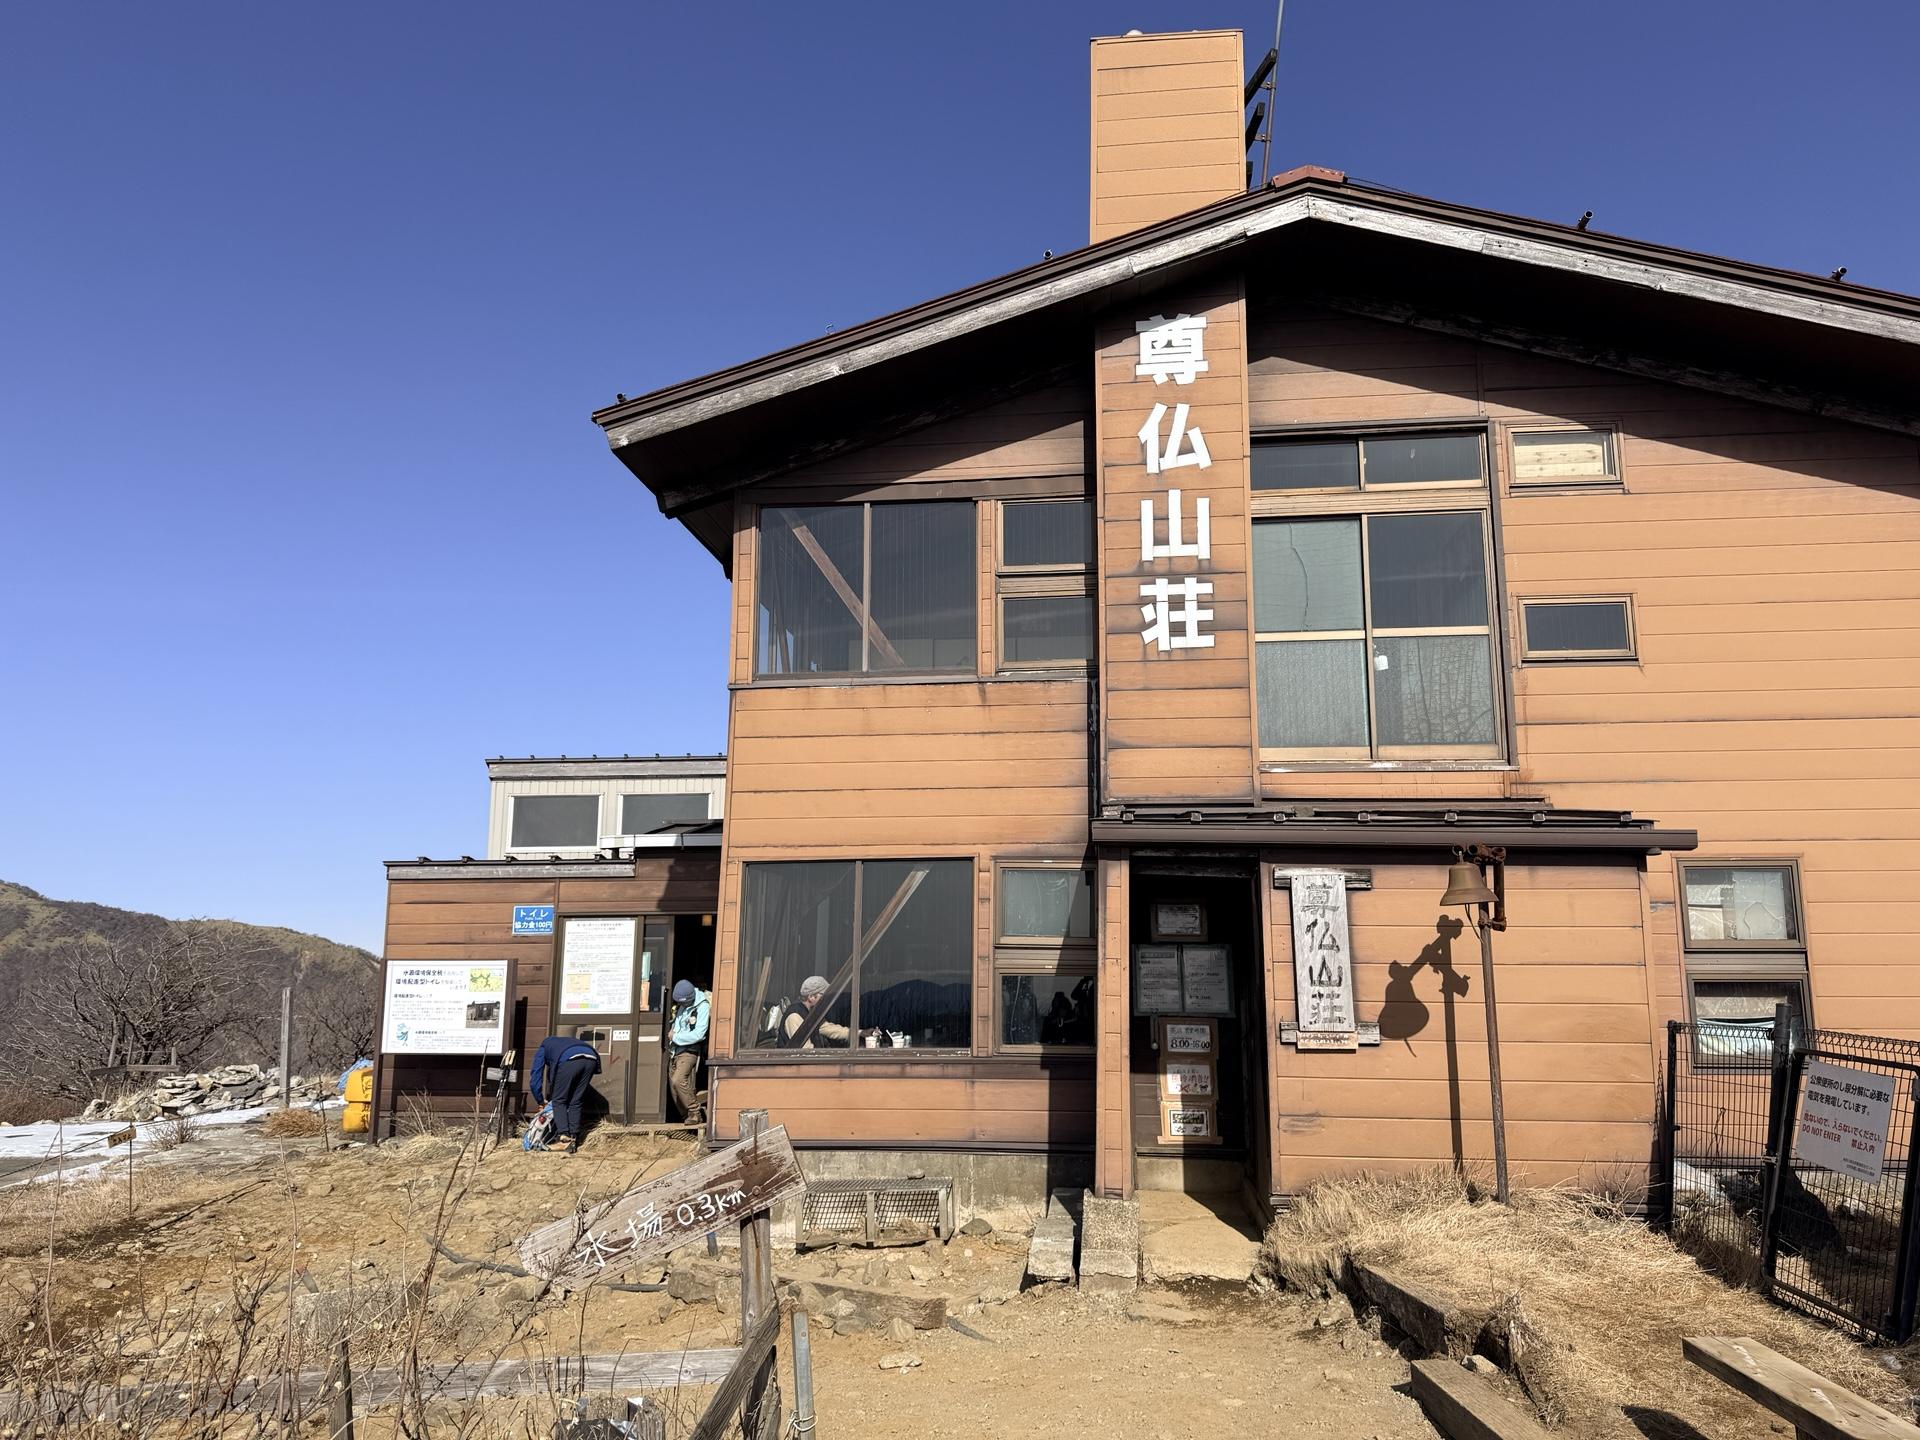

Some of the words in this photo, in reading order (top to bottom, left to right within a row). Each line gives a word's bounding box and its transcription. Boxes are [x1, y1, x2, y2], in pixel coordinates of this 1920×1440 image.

[1136, 313, 1215, 651] 尊仏山荘
[514, 921, 553, 929] 協力金100円
[520, 909, 549, 917] トイレ
[1810, 1075, 1890, 1103] 公衆便所のし尿分解に必要な
[1807, 1090, 1870, 1116] 電気を発電しています。
[1802, 1123, 1809, 1133] DO
[1811, 1127, 1822, 1137] NOT
[1823, 1131, 1842, 1143] ENTER
[575, 1202, 663, 1268] 水場
[676, 1189, 747, 1227] 0.3km
